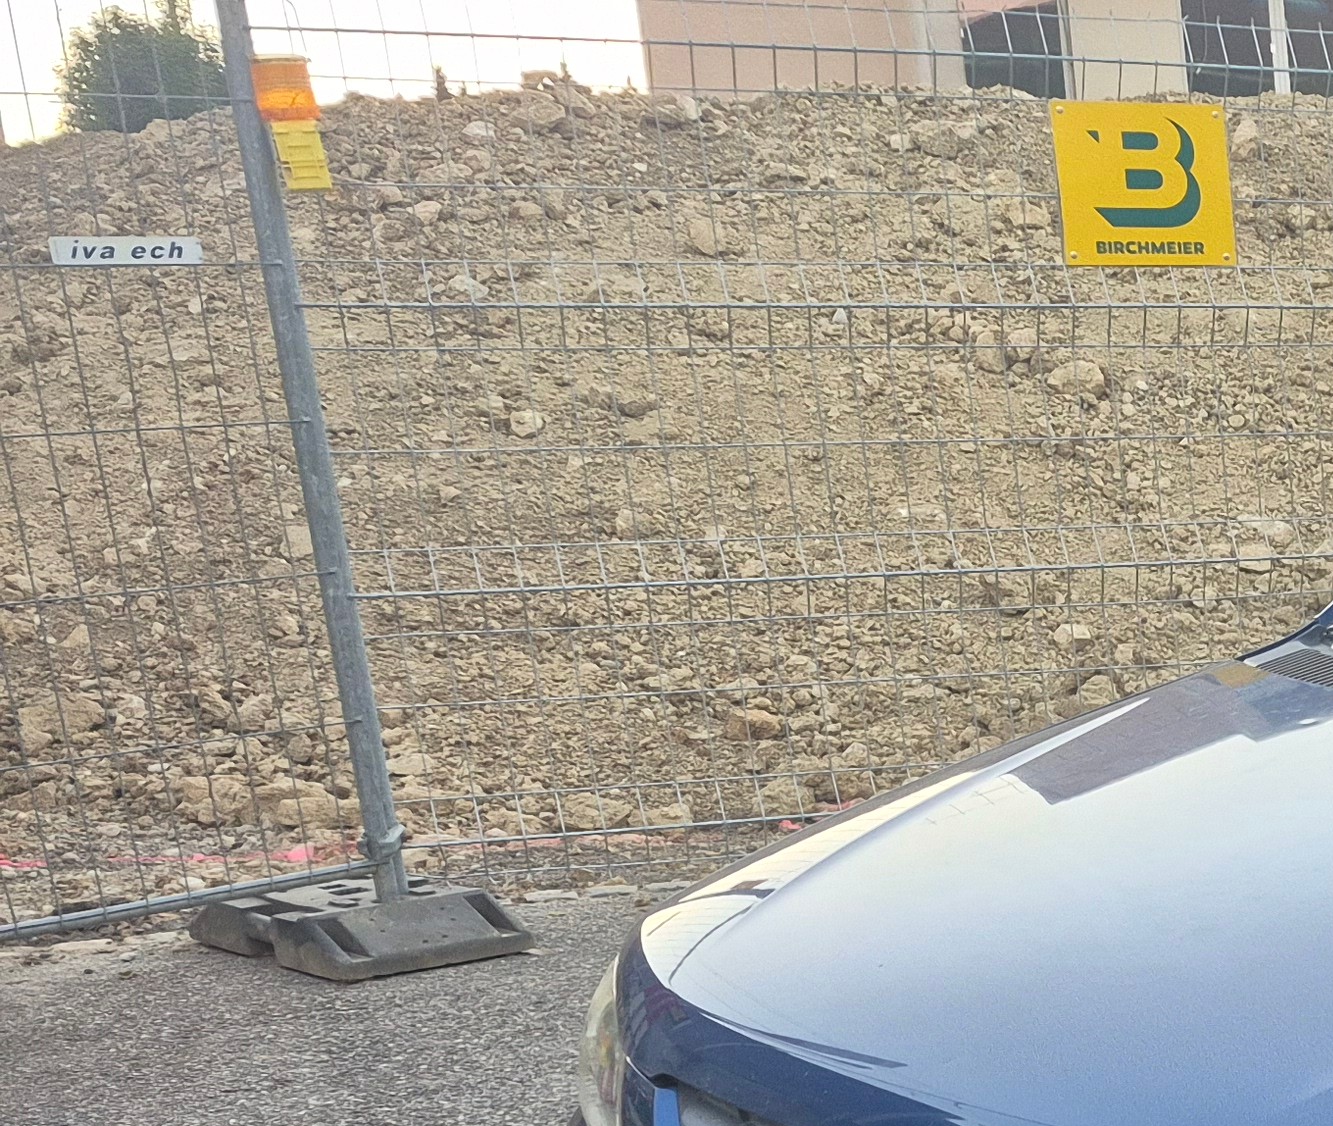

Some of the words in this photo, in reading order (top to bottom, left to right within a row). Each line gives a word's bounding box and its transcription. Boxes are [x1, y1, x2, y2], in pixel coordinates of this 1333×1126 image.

[70, 239, 115, 260] iva
[130, 241, 184, 260] ech
[1096, 240, 1205, 255] BIRCHMEIER
